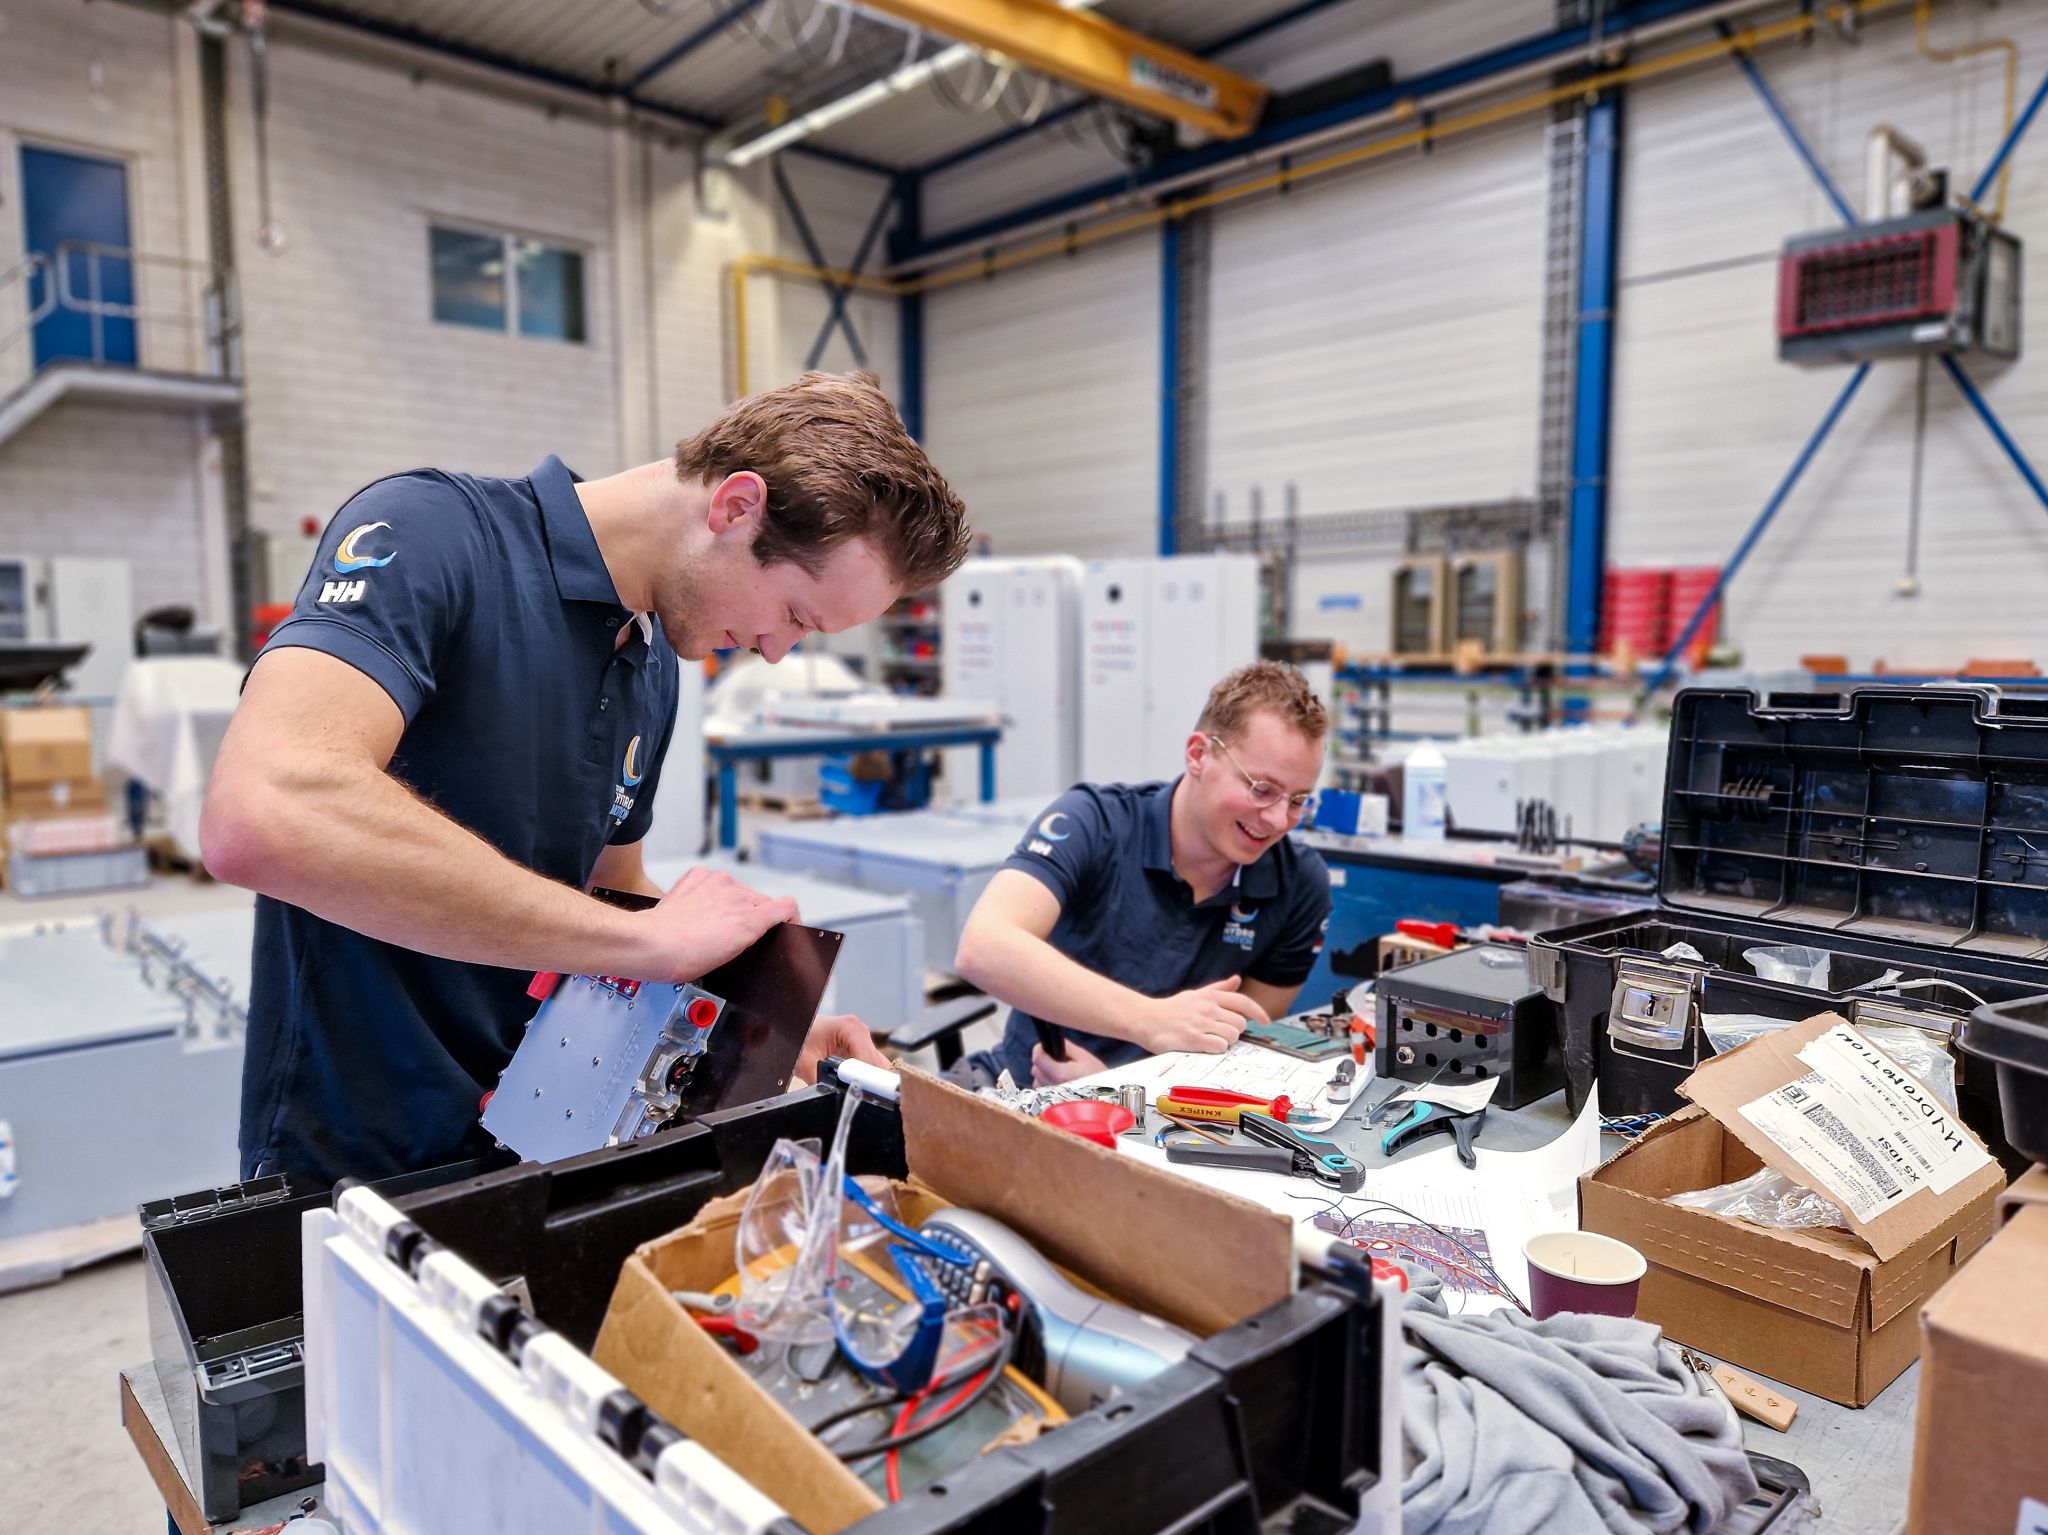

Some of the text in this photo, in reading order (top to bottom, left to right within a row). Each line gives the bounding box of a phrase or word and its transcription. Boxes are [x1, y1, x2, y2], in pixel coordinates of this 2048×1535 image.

[318, 580, 366, 603] HH
[1223, 927, 1255, 938] HYDRO
[1179, 1106, 1221, 1116] KNIPEX
[1877, 1137, 1903, 1161] IDSI
